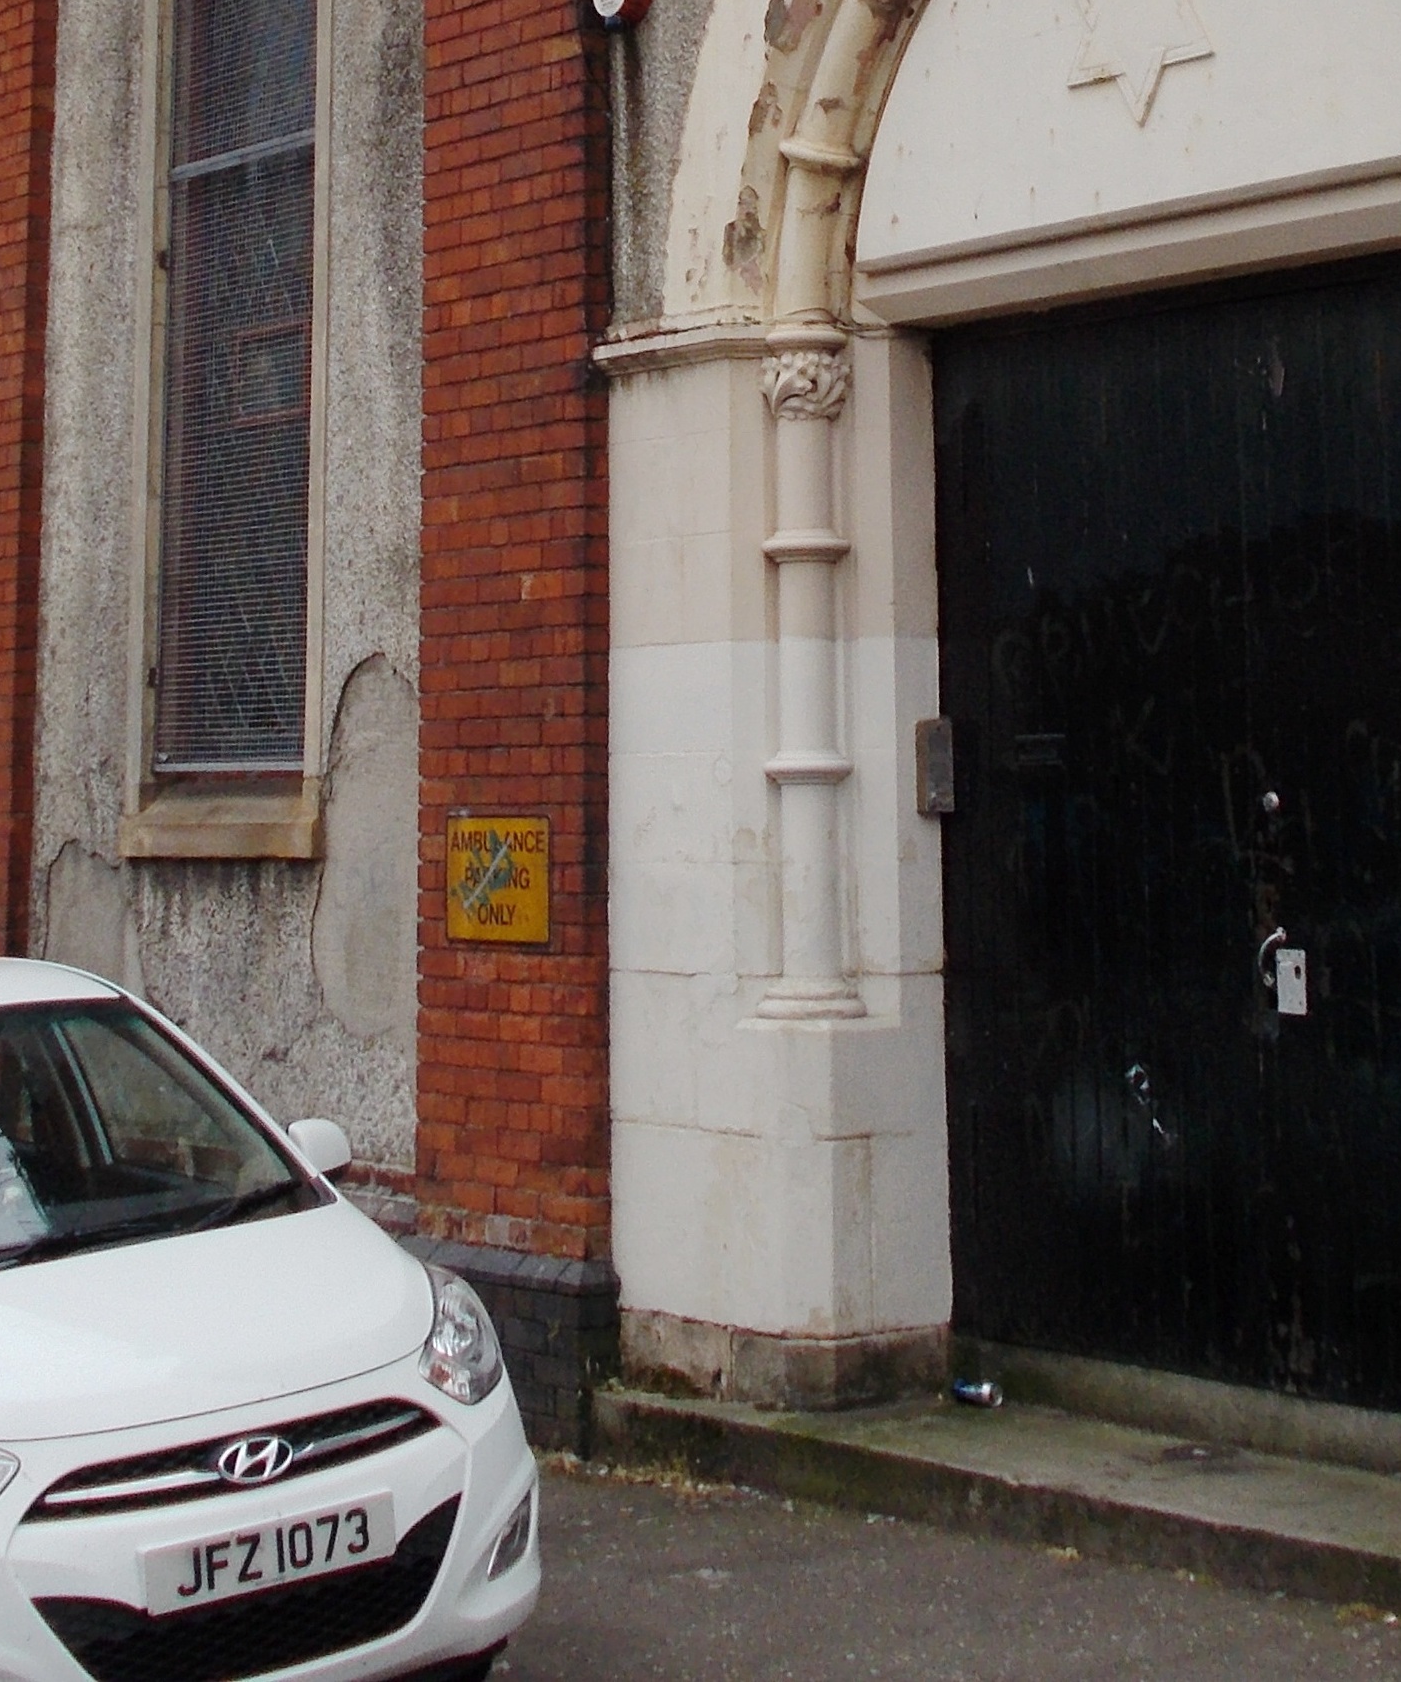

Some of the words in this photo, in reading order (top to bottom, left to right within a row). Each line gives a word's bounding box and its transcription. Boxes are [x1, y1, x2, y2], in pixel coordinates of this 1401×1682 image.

[451, 830, 545, 853] AMBUANCE
[477, 904, 516, 926] ONLY
[177, 1532, 262, 1597] JFZ
[276, 1507, 369, 1573] 1073
